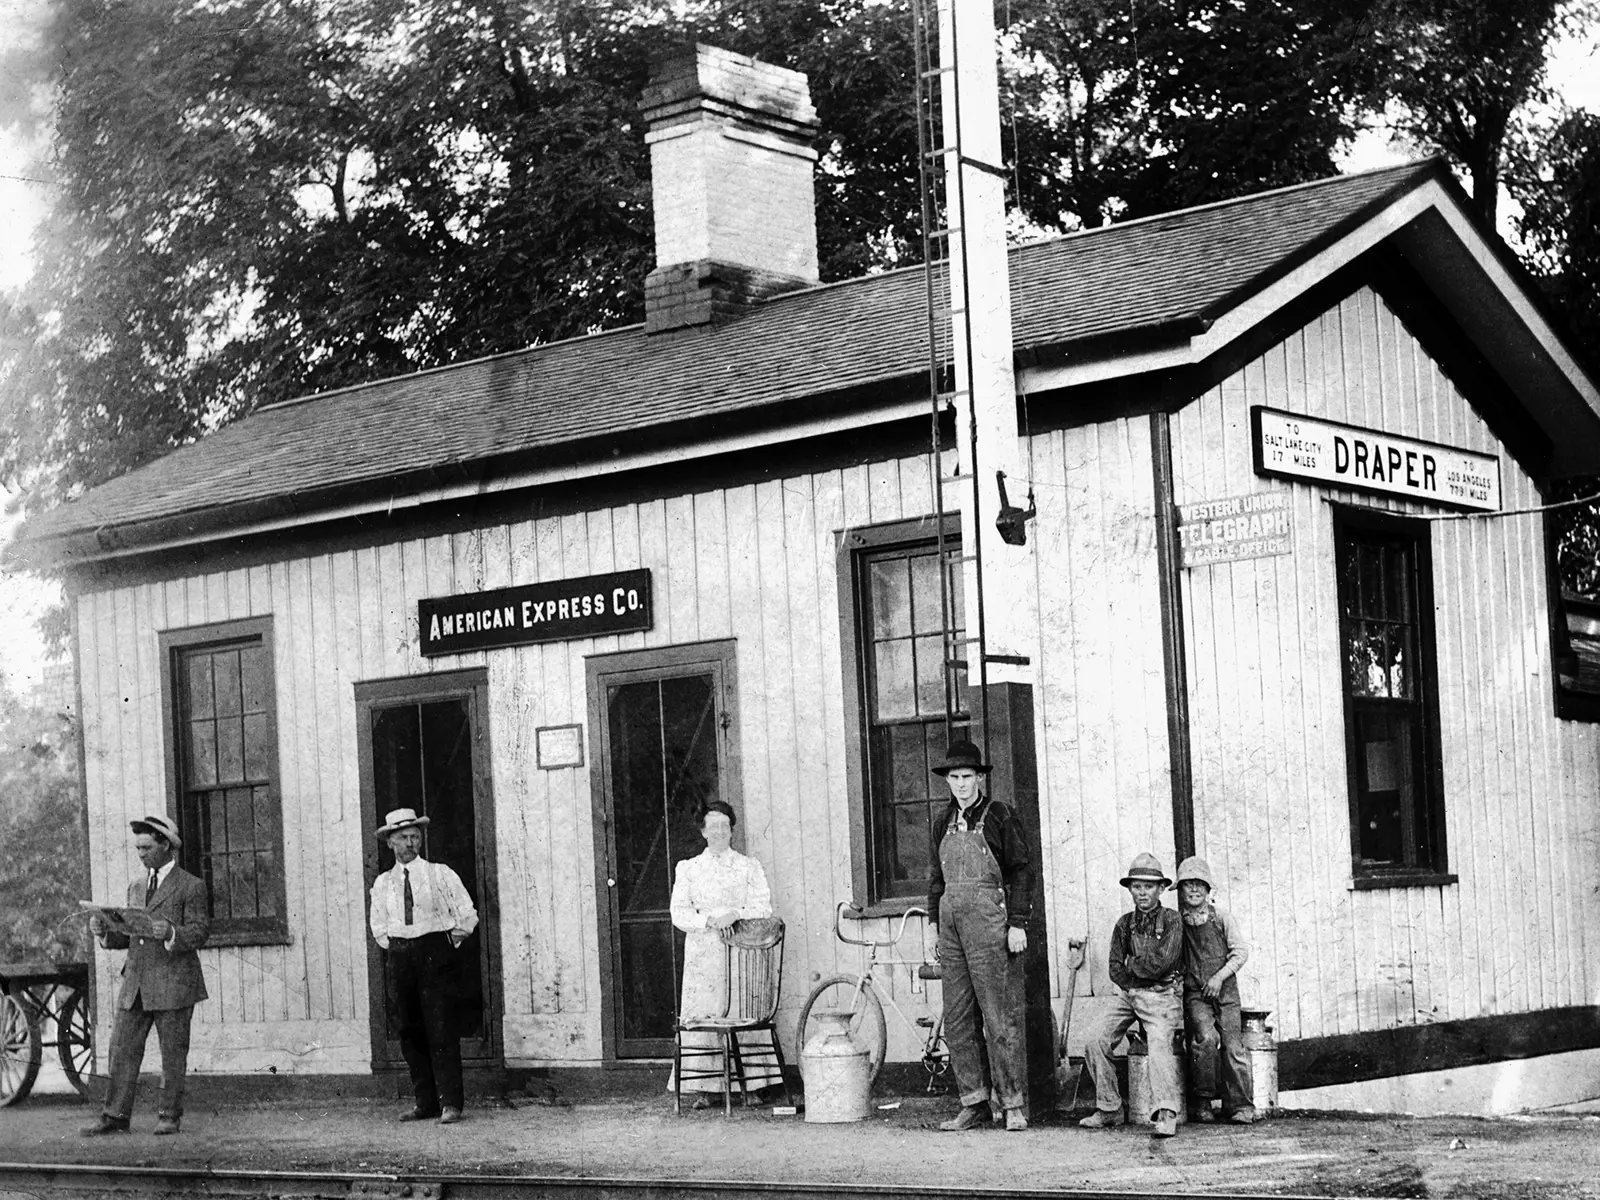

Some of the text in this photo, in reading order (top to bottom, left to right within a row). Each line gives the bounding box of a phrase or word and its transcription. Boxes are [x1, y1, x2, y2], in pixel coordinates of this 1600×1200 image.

[1286, 423, 1300, 435] TO
[1264, 433, 1322, 455] SALT LAKE CITY
[1273, 450, 1316, 469] 17 MILES
[1334, 435, 1436, 492] DRAPER
[1463, 460, 1475, 472] TO
[1447, 470, 1491, 490] LOS ANGELES
[1469, 488, 1488, 501] MILES
[1180, 493, 1284, 521] WESTERN UNION
[1177, 510, 1288, 548] TELEGRAPH
[1239, 538, 1285, 557] OFFICE
[429, 606, 515, 641] AMERICAN
[522, 593, 605, 629] EXPRESS
